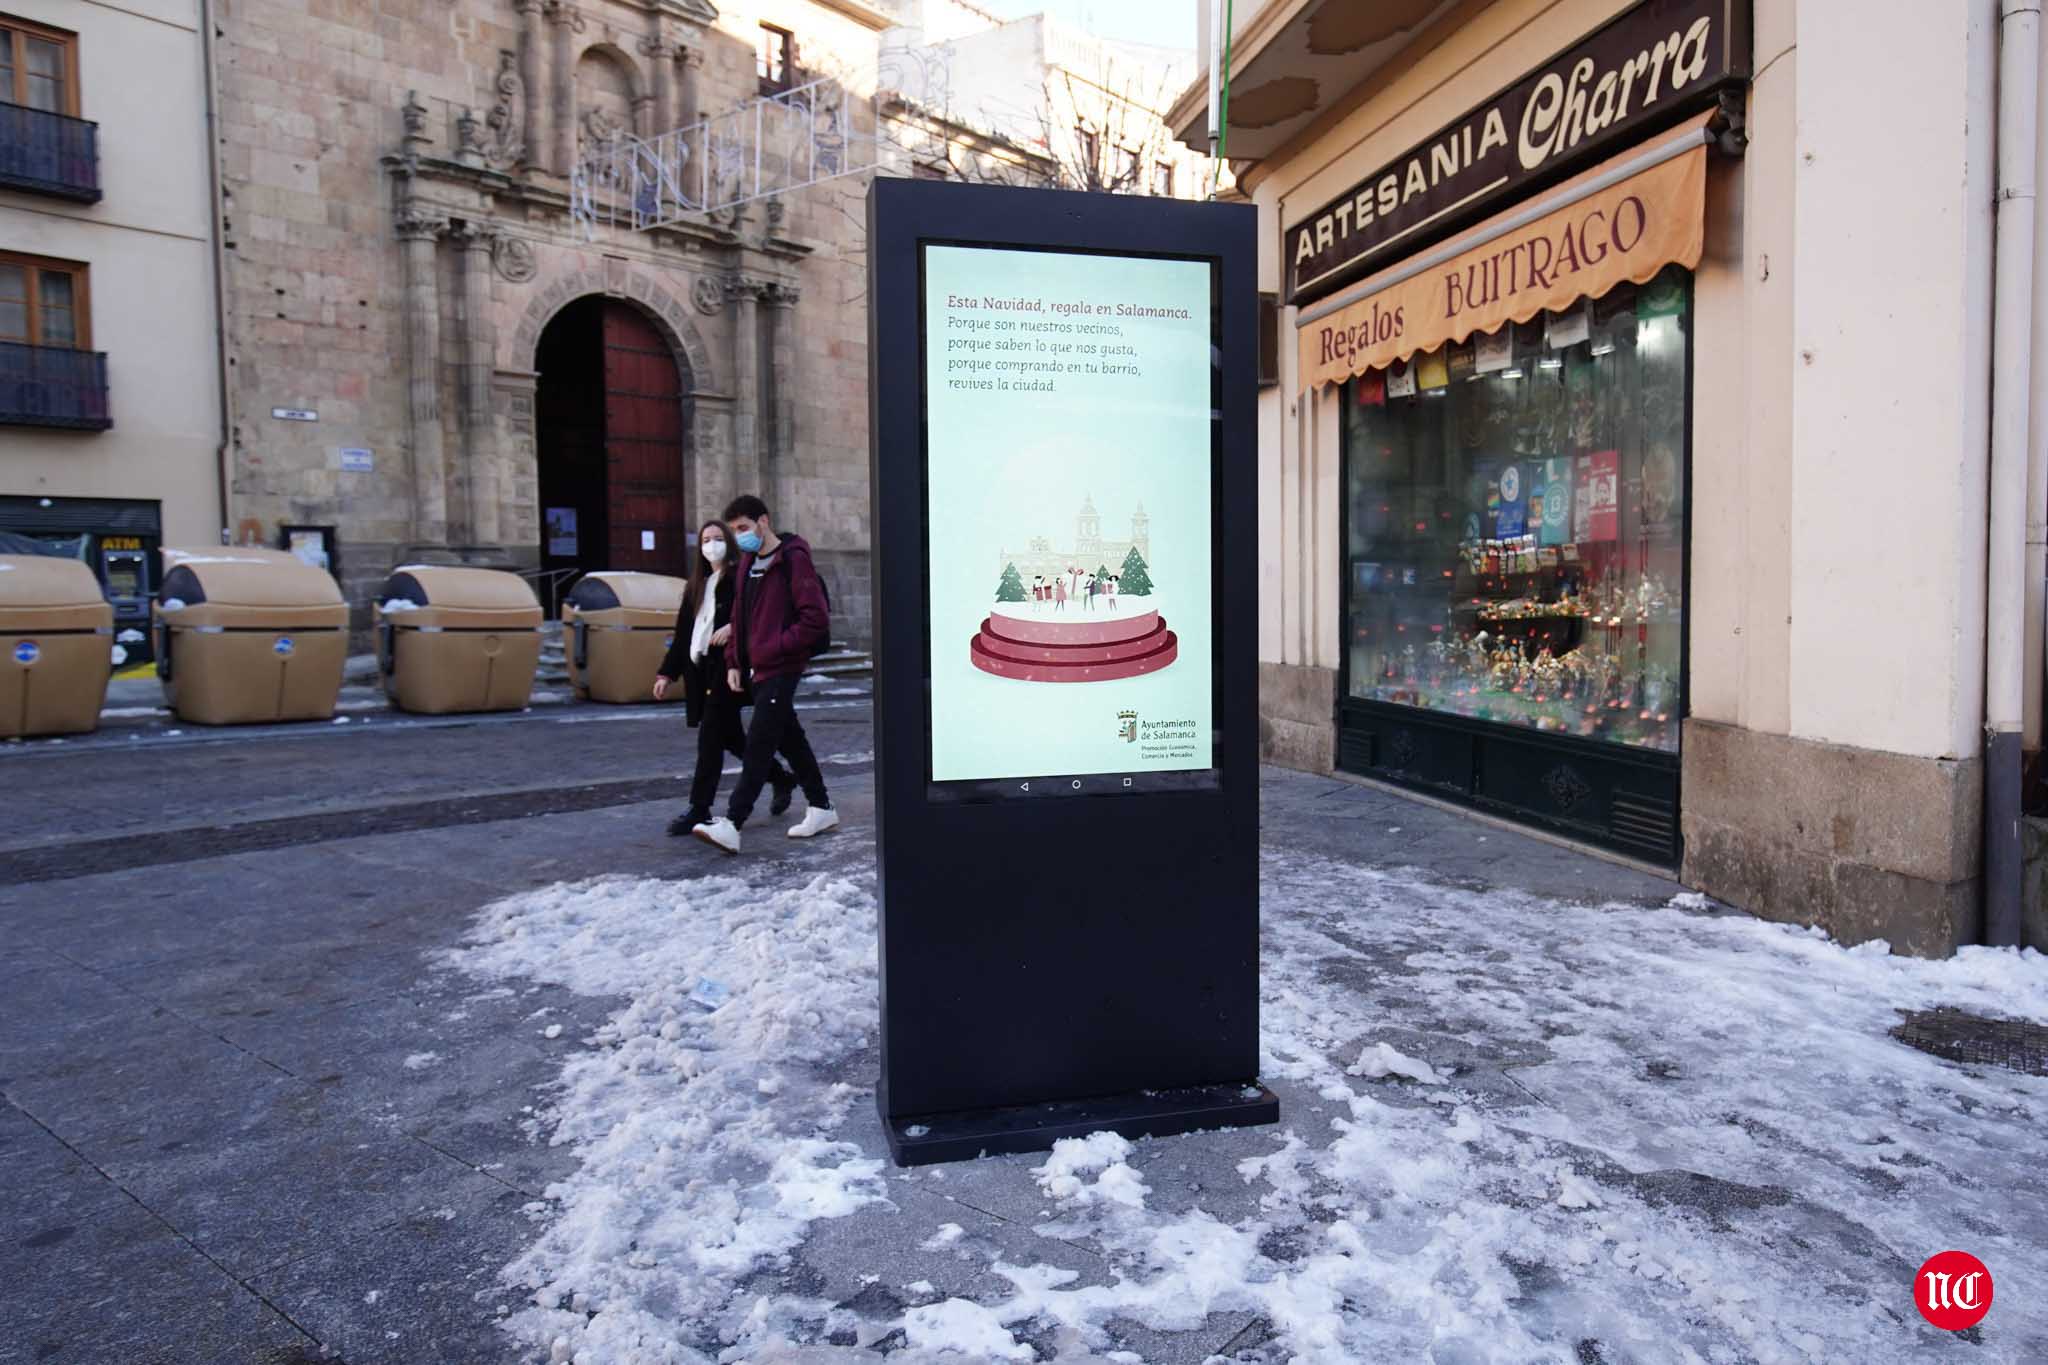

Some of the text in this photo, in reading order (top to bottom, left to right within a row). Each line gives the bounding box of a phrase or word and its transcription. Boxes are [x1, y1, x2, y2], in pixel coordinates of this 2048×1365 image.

[1294, 15, 1711, 265] ARTESANIA Charra
[1319, 195, 1647, 369] Regalos BUITRAGO
[947, 295, 1193, 320] Esta Navidad, regala en Salamanca.
[947, 316, 1124, 337] Porque son nuestros vecinos,
[947, 337, 1138, 358] porque saben lo que nos gusta,
[947, 359, 1142, 377] porque comprando en tu barrio,
[948, 377, 1057, 392] revives la ciudad.
[101, 536, 142, 551] ATM
[1141, 719, 1197, 731] Ayuntamiento
[1141, 730, 1196, 740] de Salamanca
